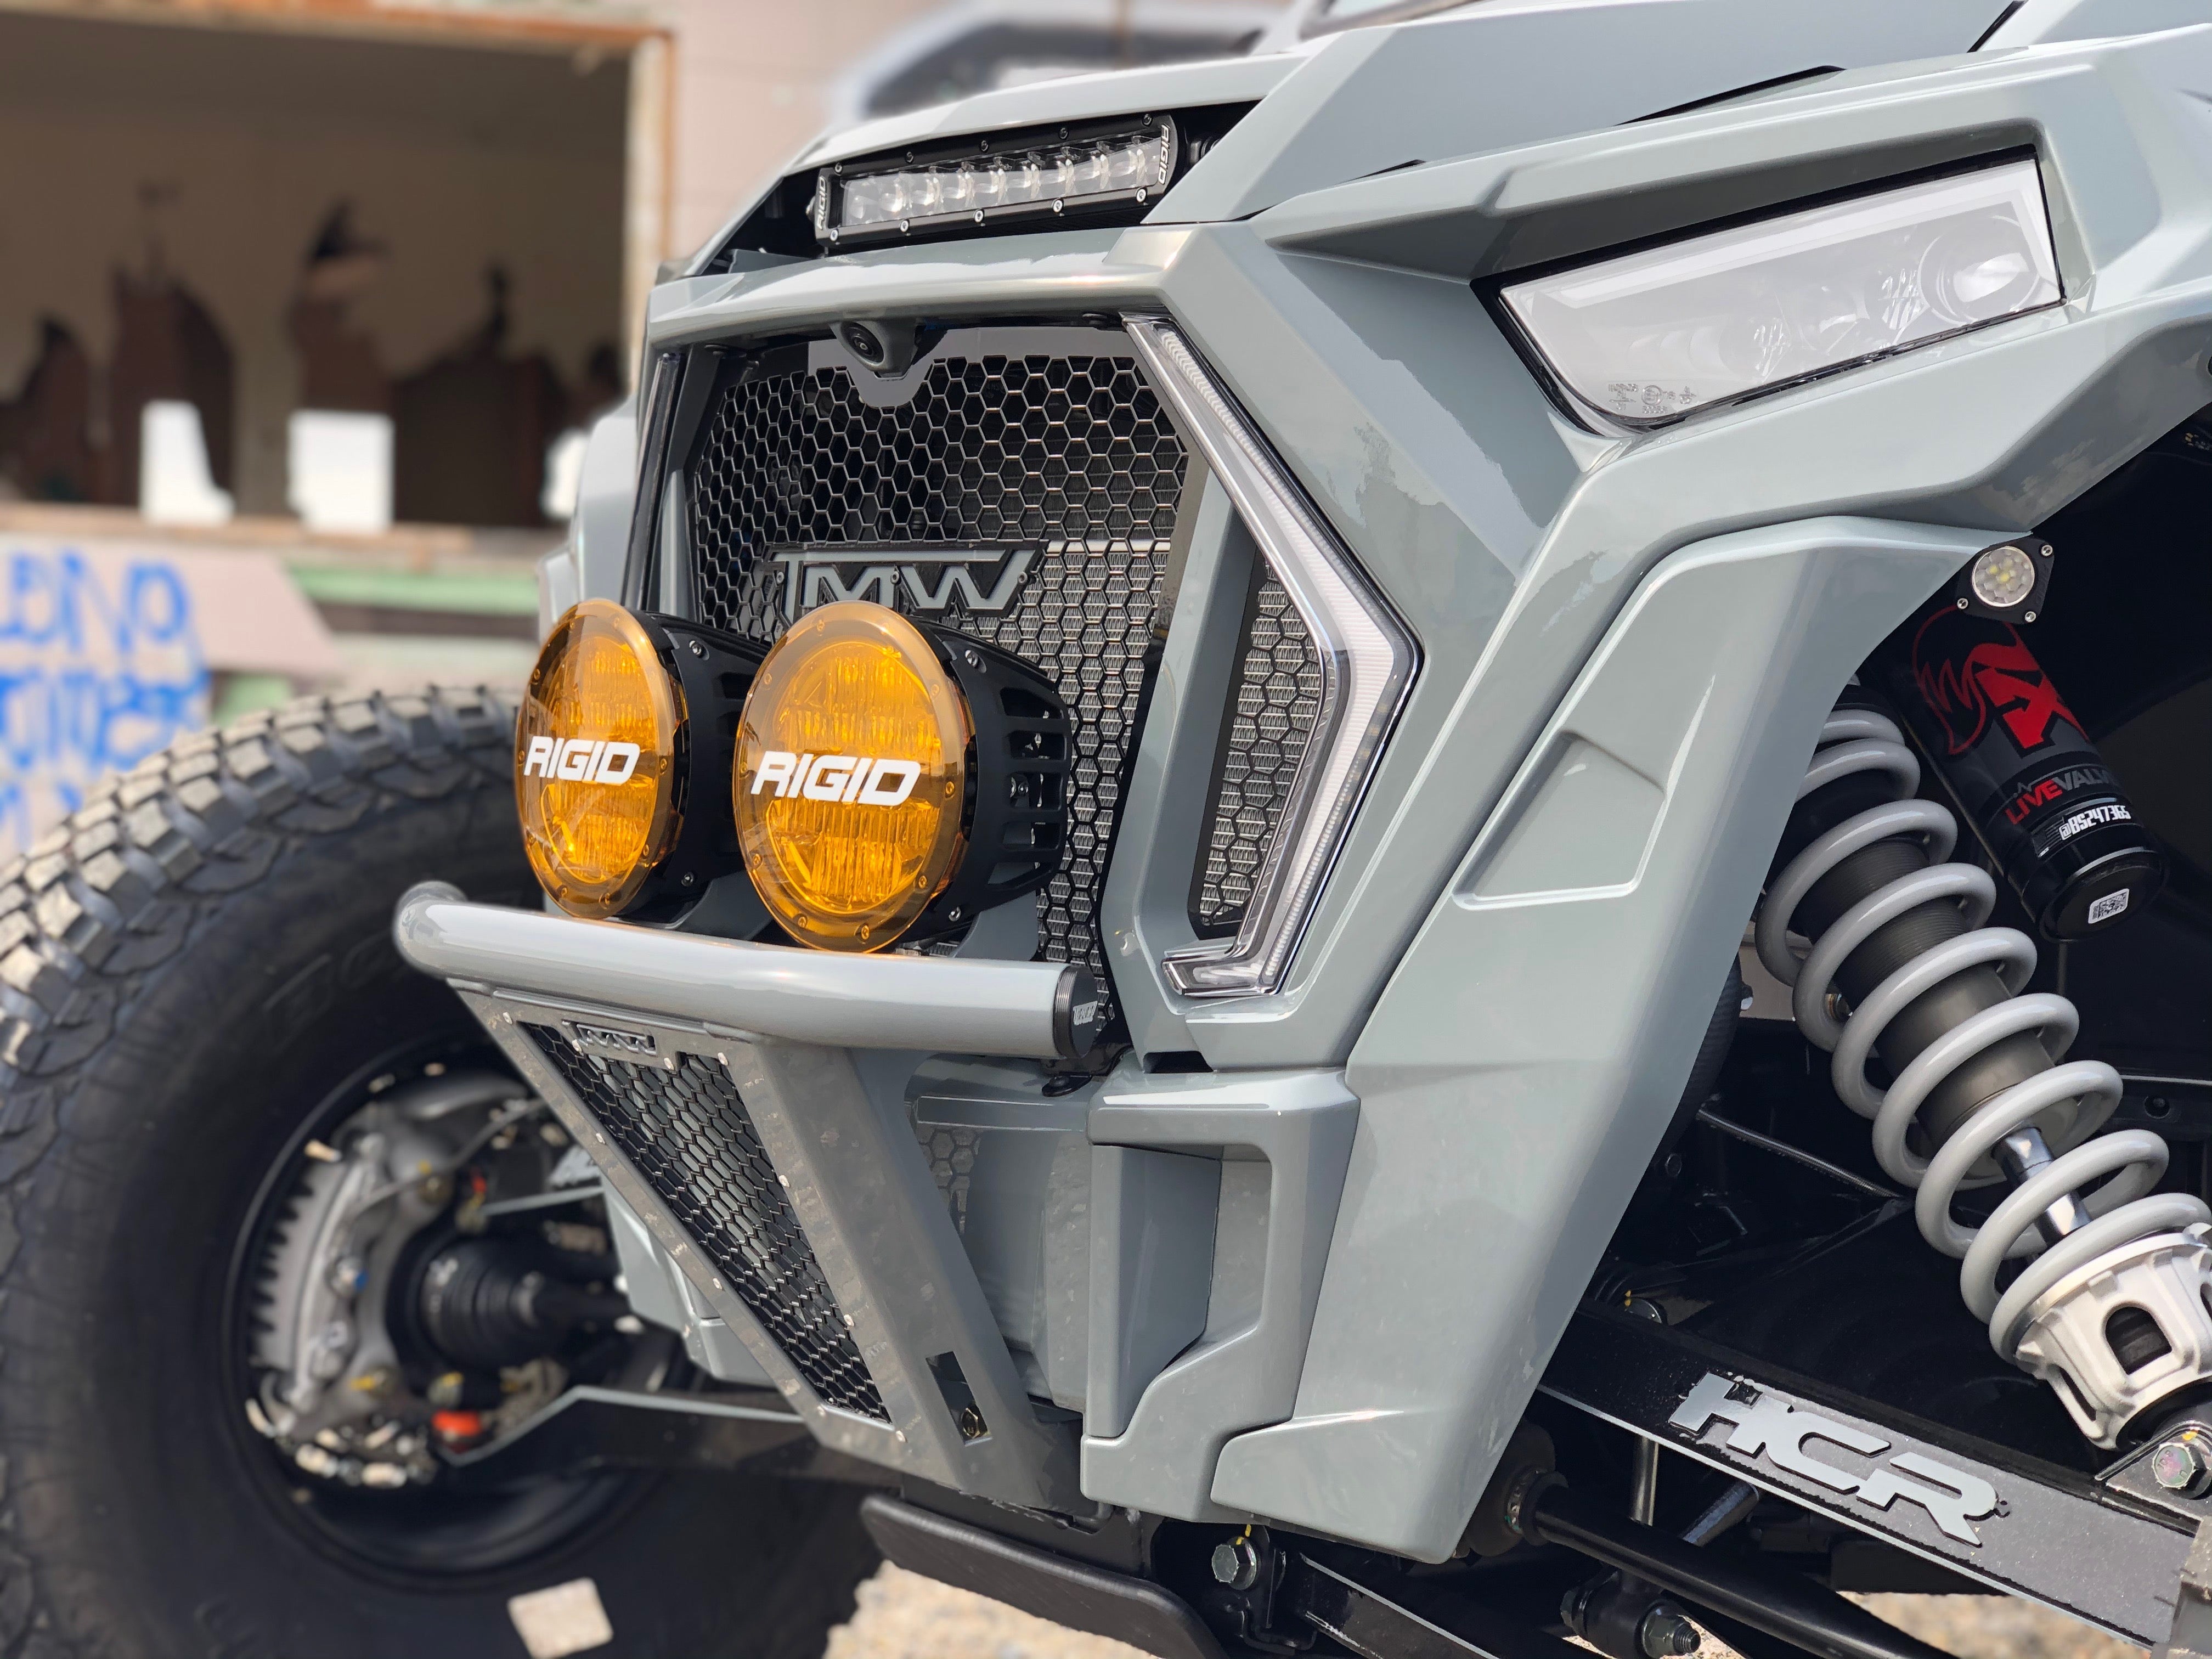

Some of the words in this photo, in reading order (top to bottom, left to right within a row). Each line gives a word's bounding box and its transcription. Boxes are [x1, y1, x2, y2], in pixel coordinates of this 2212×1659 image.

[1158, 124, 1170, 184] RIGID
[817, 176, 826, 230] RIGID
[771, 549, 1036, 624] TMW
[524, 736, 641, 785] RIGID
[751, 751, 921, 806] RIGID
[2005, 769, 2112, 825] LIVEVALV
[2058, 805, 2131, 840] @BS247365
[1669, 1372, 2001, 1549] HCR
